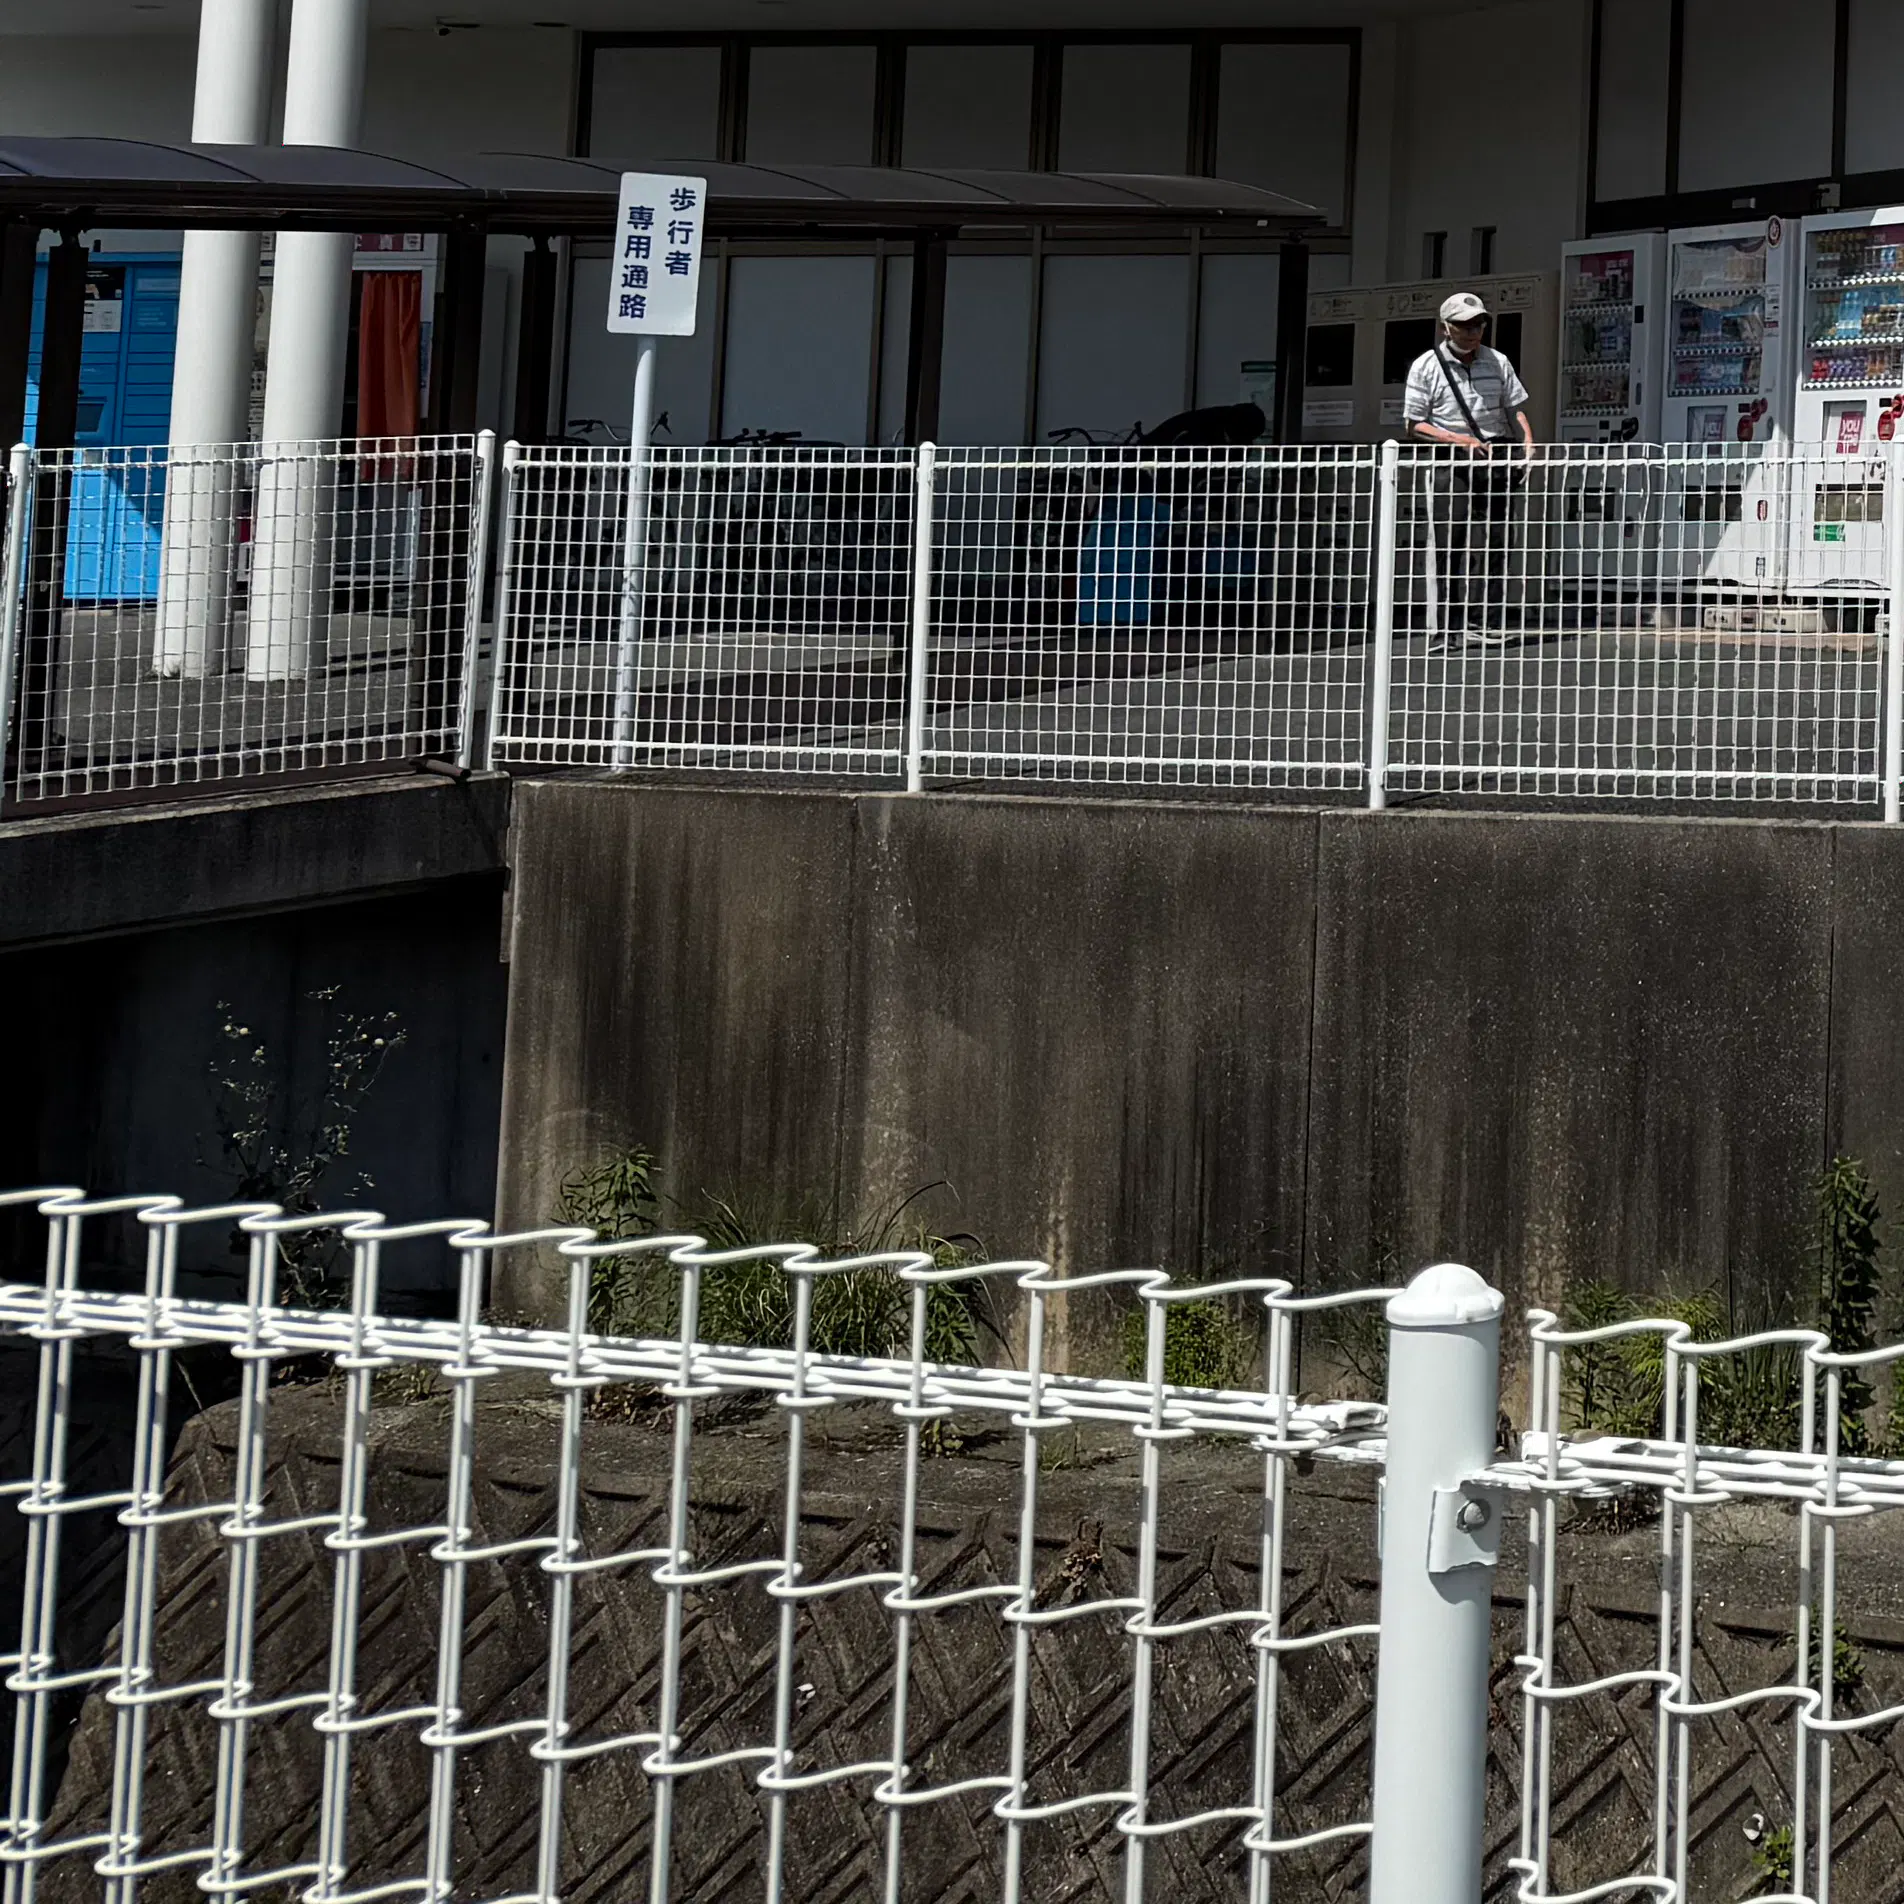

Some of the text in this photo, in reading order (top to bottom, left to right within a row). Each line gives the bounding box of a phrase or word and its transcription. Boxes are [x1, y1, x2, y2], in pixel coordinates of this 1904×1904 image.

[618, 205, 655, 320] 専用通路
[664, 186, 697, 276] 歩行者
